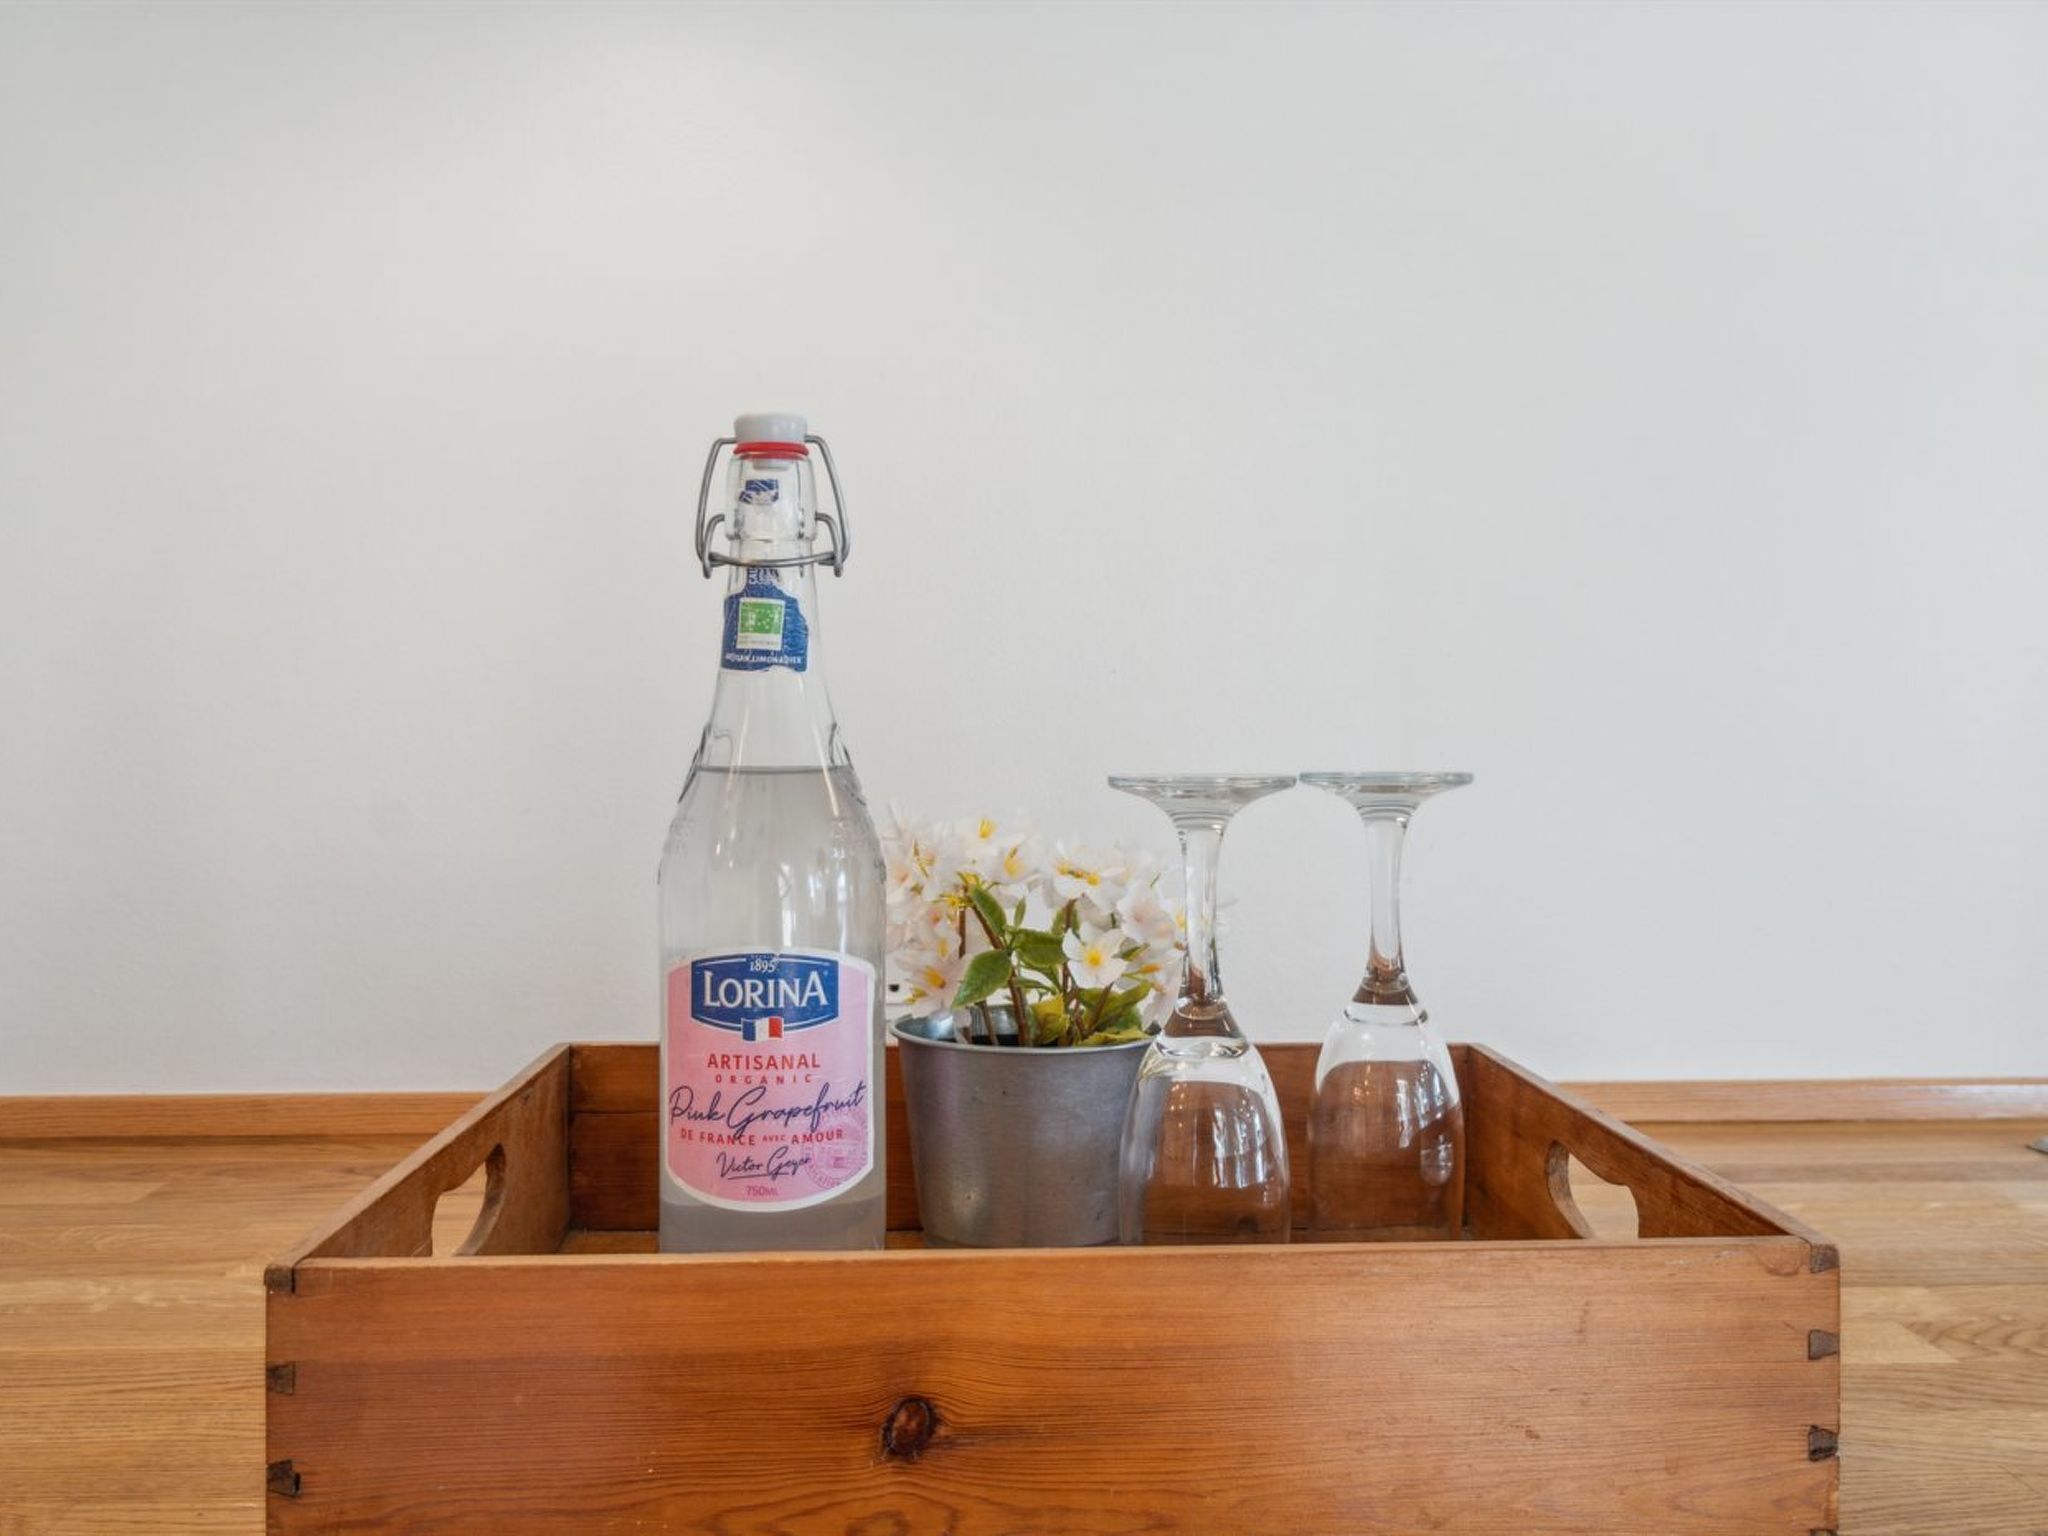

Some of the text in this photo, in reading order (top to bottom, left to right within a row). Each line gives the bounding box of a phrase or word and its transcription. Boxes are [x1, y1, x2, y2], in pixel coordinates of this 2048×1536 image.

[750, 958, 778, 974] 1895
[703, 970, 828, 1008] LORINA
[707, 1053, 821, 1070] ARTISANAL
[715, 1074, 812, 1085] ORGANIC
[669, 1081, 867, 1140] Pink Grapefruit
[680, 1127, 844, 1146] DE FRANCE AVEC AMOUR
[716, 1151, 763, 1180] Victor
